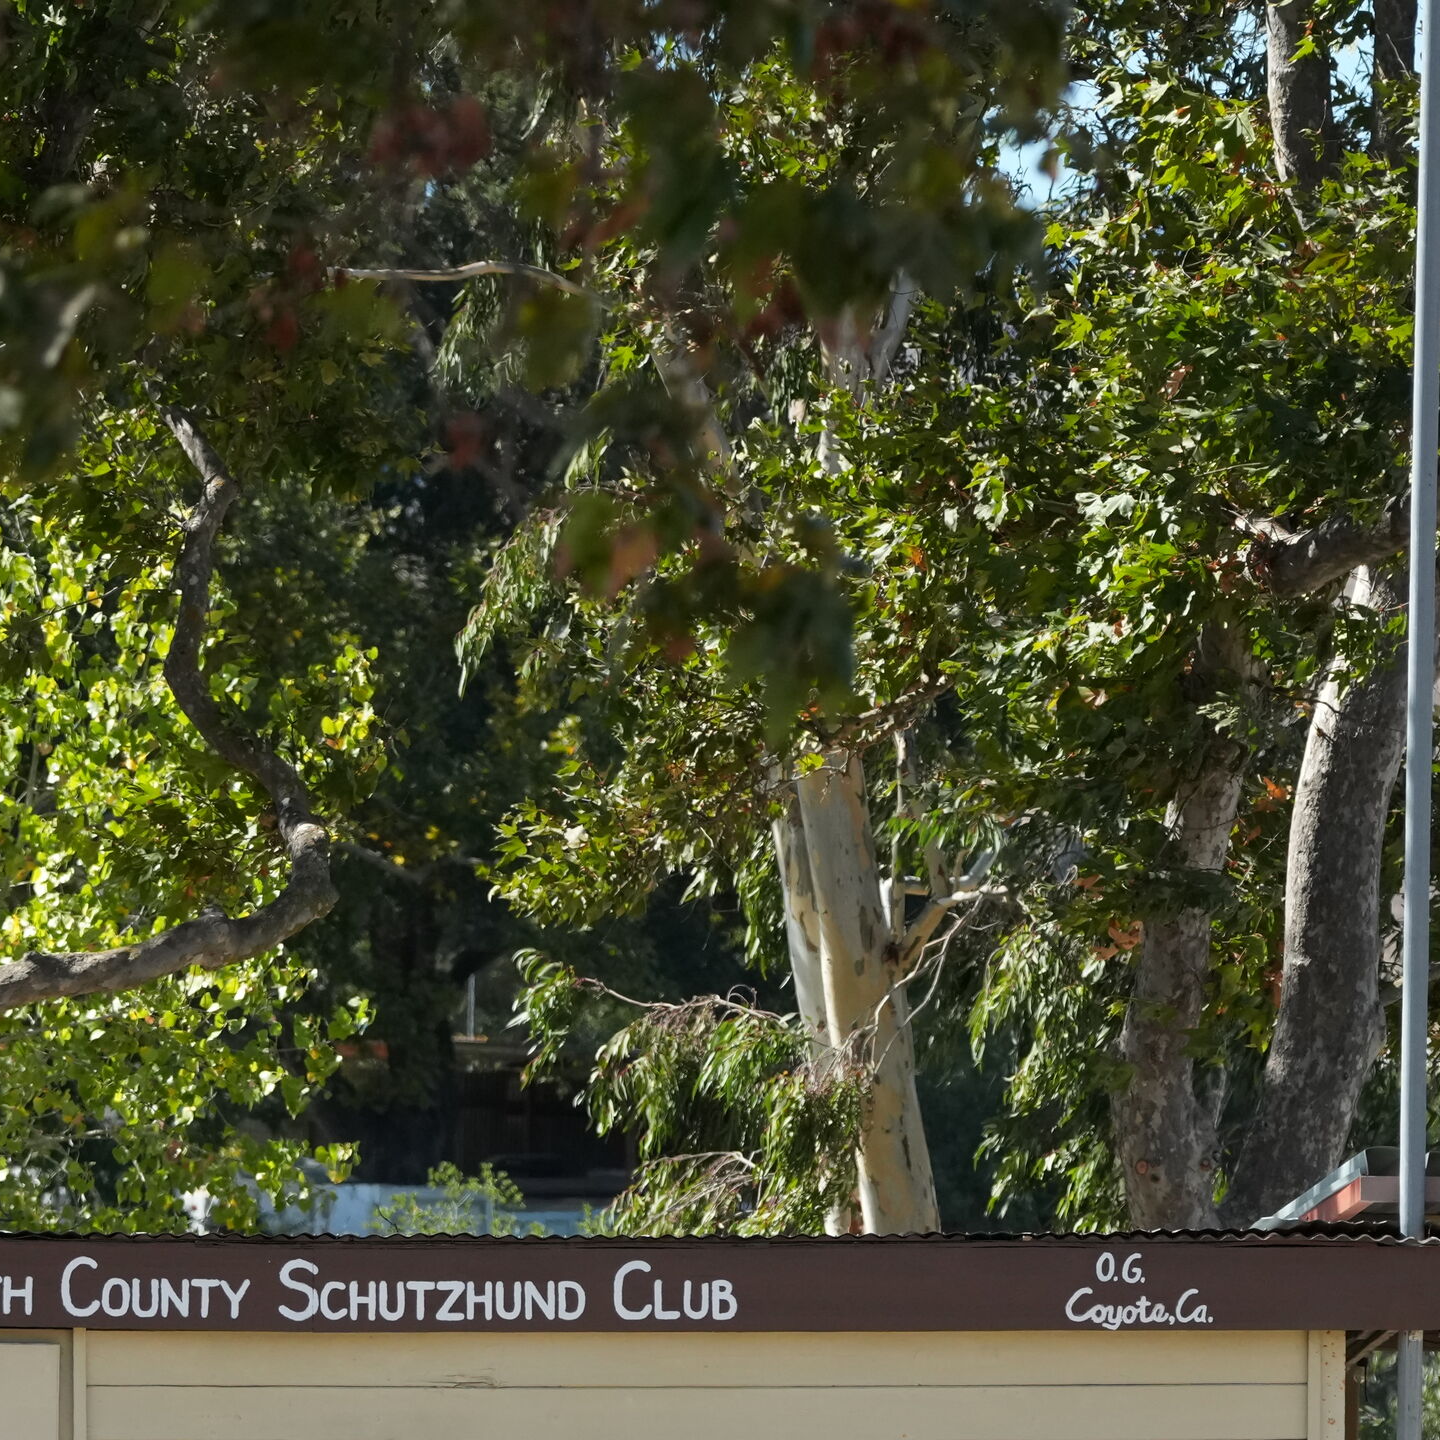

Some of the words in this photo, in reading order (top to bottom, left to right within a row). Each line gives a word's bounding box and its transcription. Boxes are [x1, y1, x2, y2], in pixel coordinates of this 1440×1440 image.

[61, 1256, 250, 1319] COUNTY
[279, 1258, 585, 1321] SCHUTZHUND
[614, 1261, 737, 1320] CLUB
